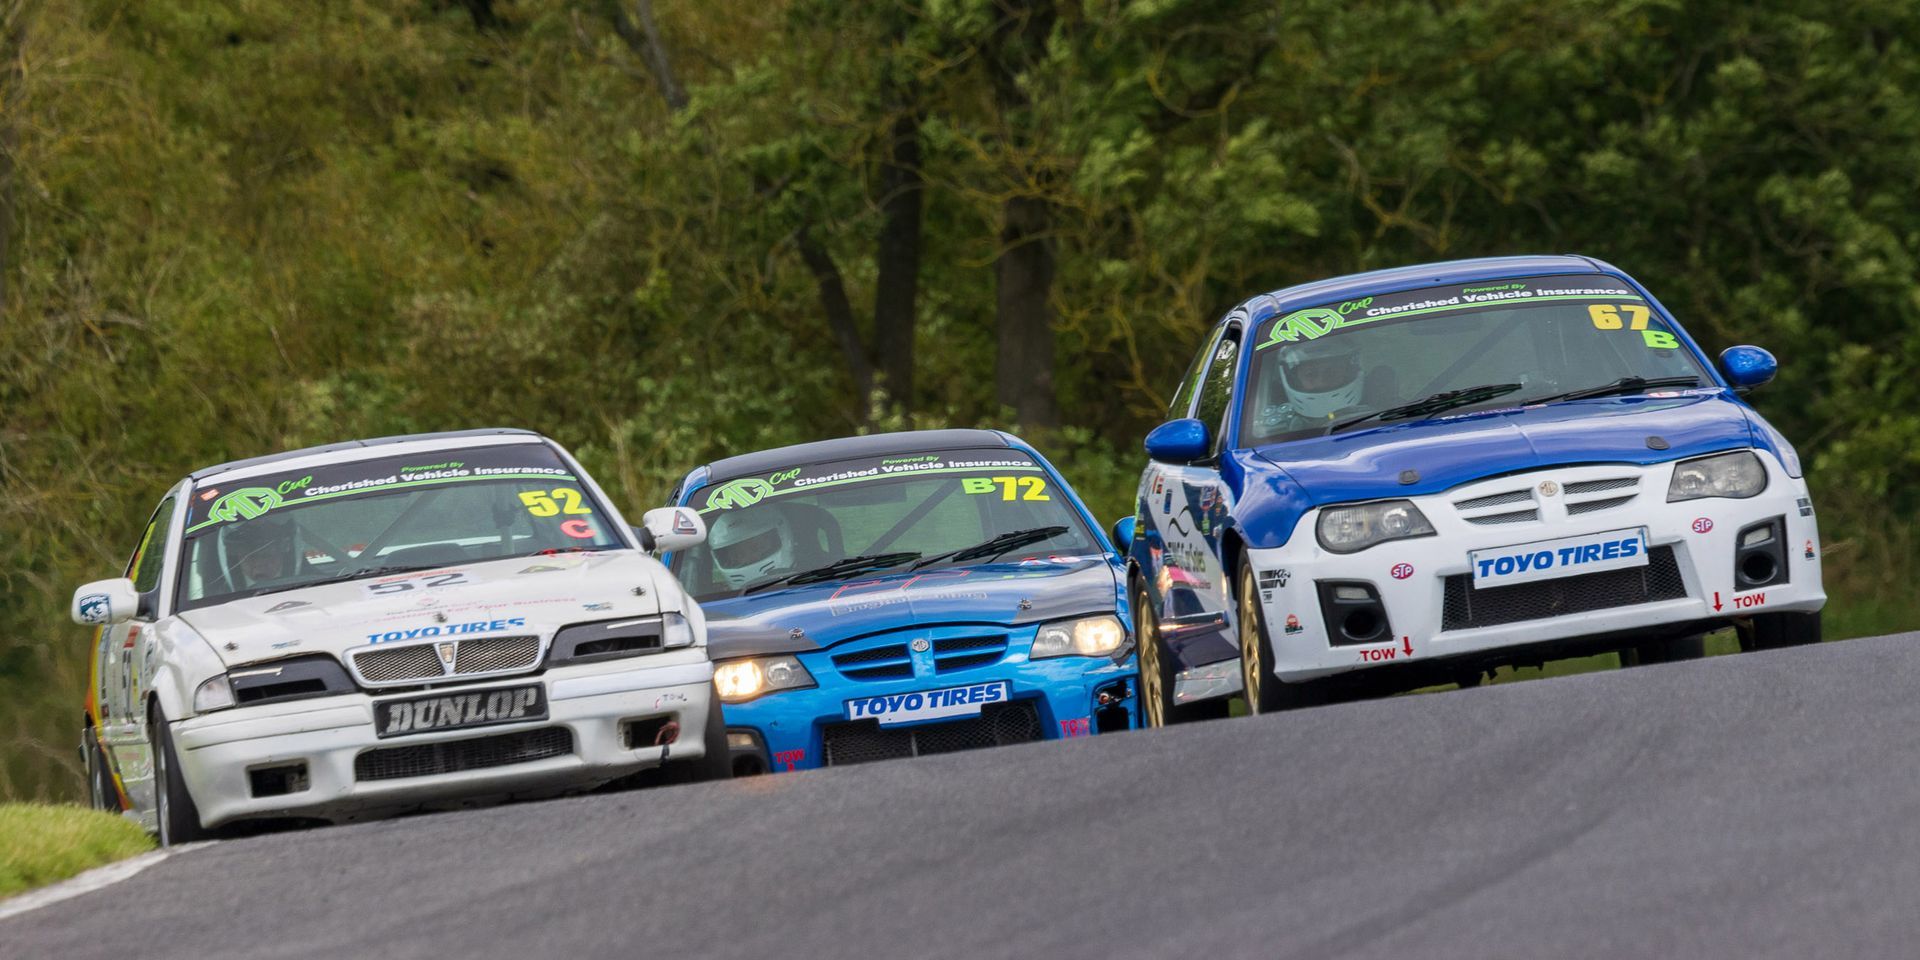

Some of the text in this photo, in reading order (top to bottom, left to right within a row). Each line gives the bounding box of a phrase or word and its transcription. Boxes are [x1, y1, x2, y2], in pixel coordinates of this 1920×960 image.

[1462, 283, 1526, 294] Powered By
[1338, 296, 1374, 315] Cup
[1366, 287, 1628, 317] Cherished Vehicle Insurance
[1274, 309, 1342, 341] MG
[1588, 303, 1651, 330] 67
[1641, 330, 1679, 349] B
[400, 461, 464, 473] Powered By
[882, 455, 939, 465] Powered By
[304, 466, 567, 497] Cherished Vehicle Insurance
[769, 467, 801, 485] Cup
[794, 460, 1032, 486] Cherished Vehicle Insurance
[277, 475, 313, 495] Cup
[710, 479, 771, 509] MG
[212, 489, 281, 521] MG
[518, 487, 592, 517] 52
[560, 519, 596, 539] C
[1693, 518, 1713, 532] STP
[1478, 538, 1638, 577] TOYO TIRES
[1392, 564, 1412, 578] STP
[368, 573, 468, 595] 52
[1733, 593, 1765, 609] TOW
[367, 617, 526, 645] TOYO TIRES
[1360, 648, 1396, 662] TOW
[852, 683, 1001, 716] TOYO TIRES
[386, 687, 537, 734] DUNLOP
[774, 749, 804, 764] TOW
